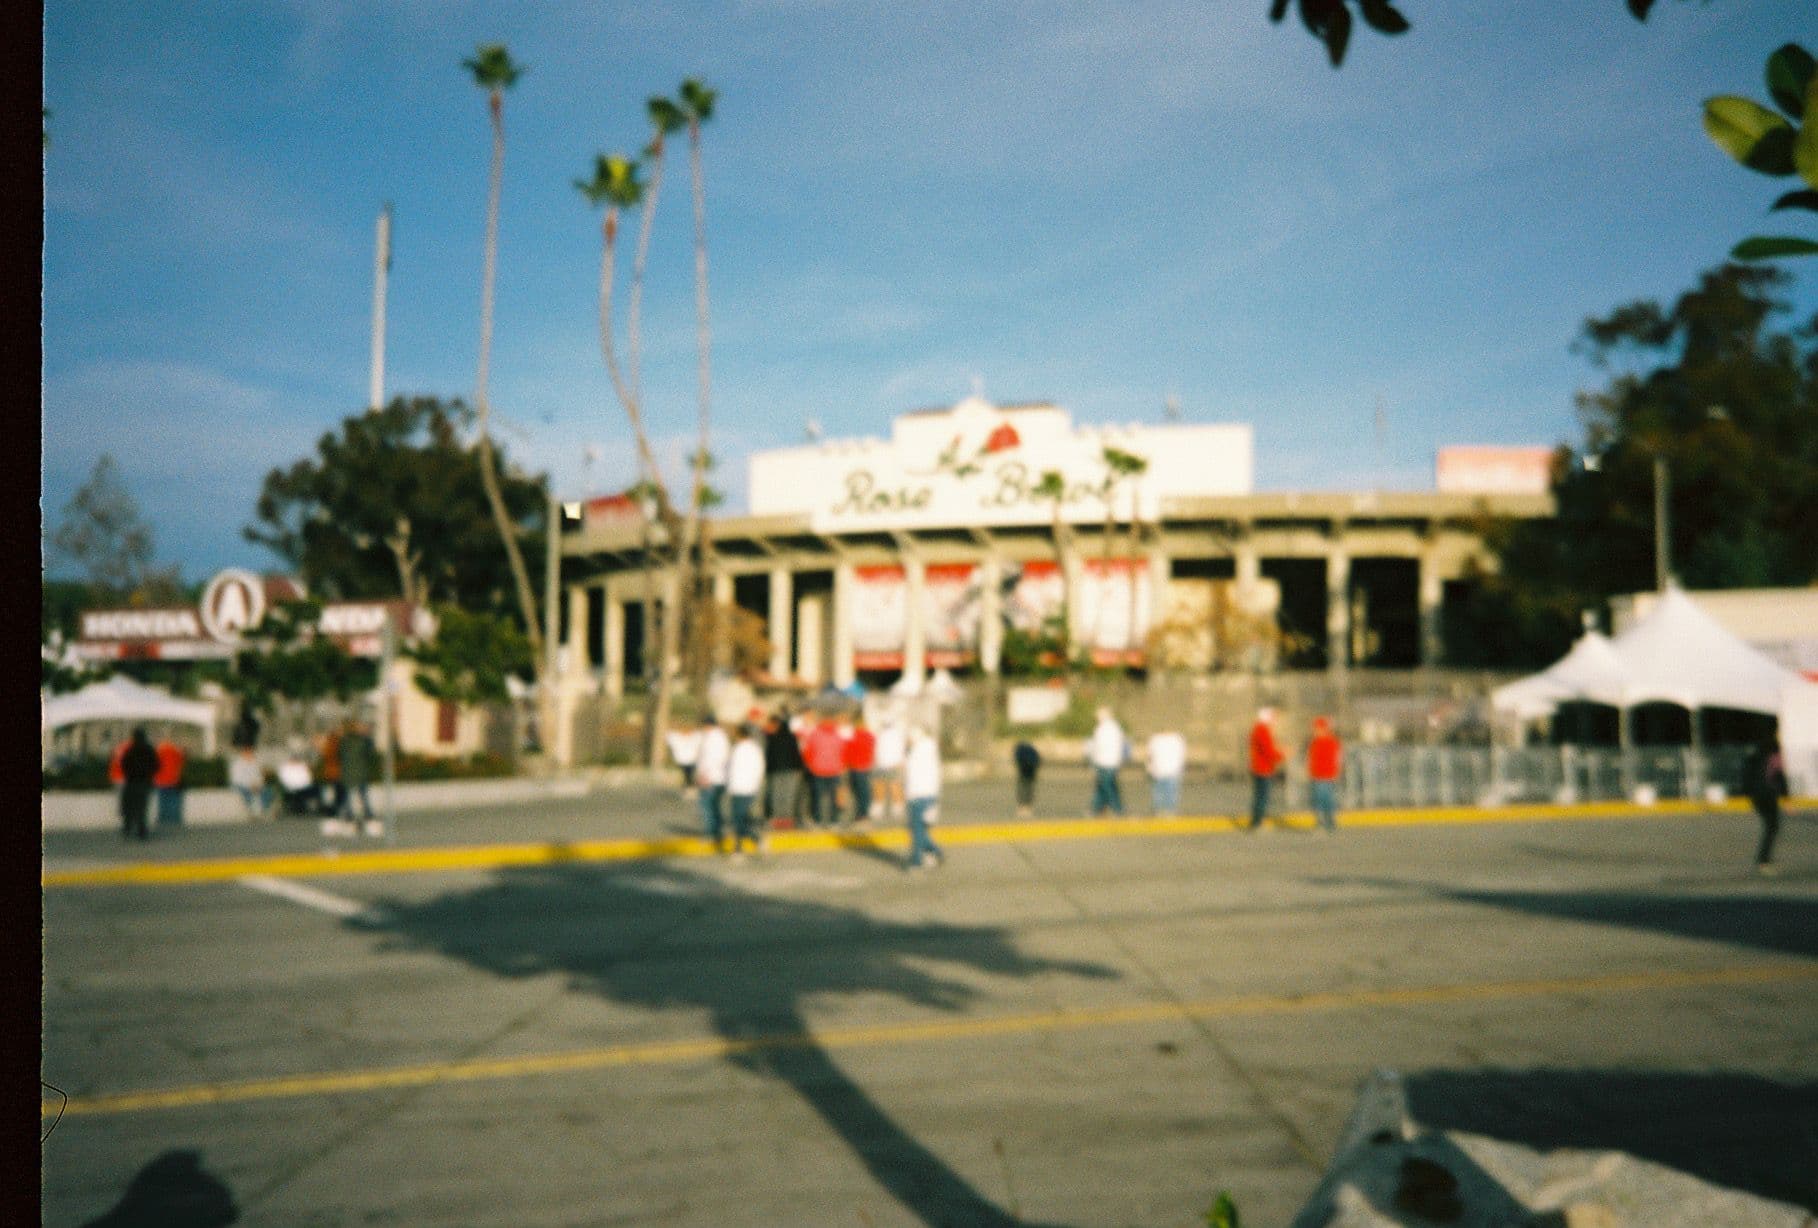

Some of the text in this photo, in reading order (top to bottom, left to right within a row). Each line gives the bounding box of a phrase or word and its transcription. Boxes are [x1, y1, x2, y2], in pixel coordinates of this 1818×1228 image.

[832, 461, 1114, 515] Rose Bw
[83, 610, 200, 639] HONDA
